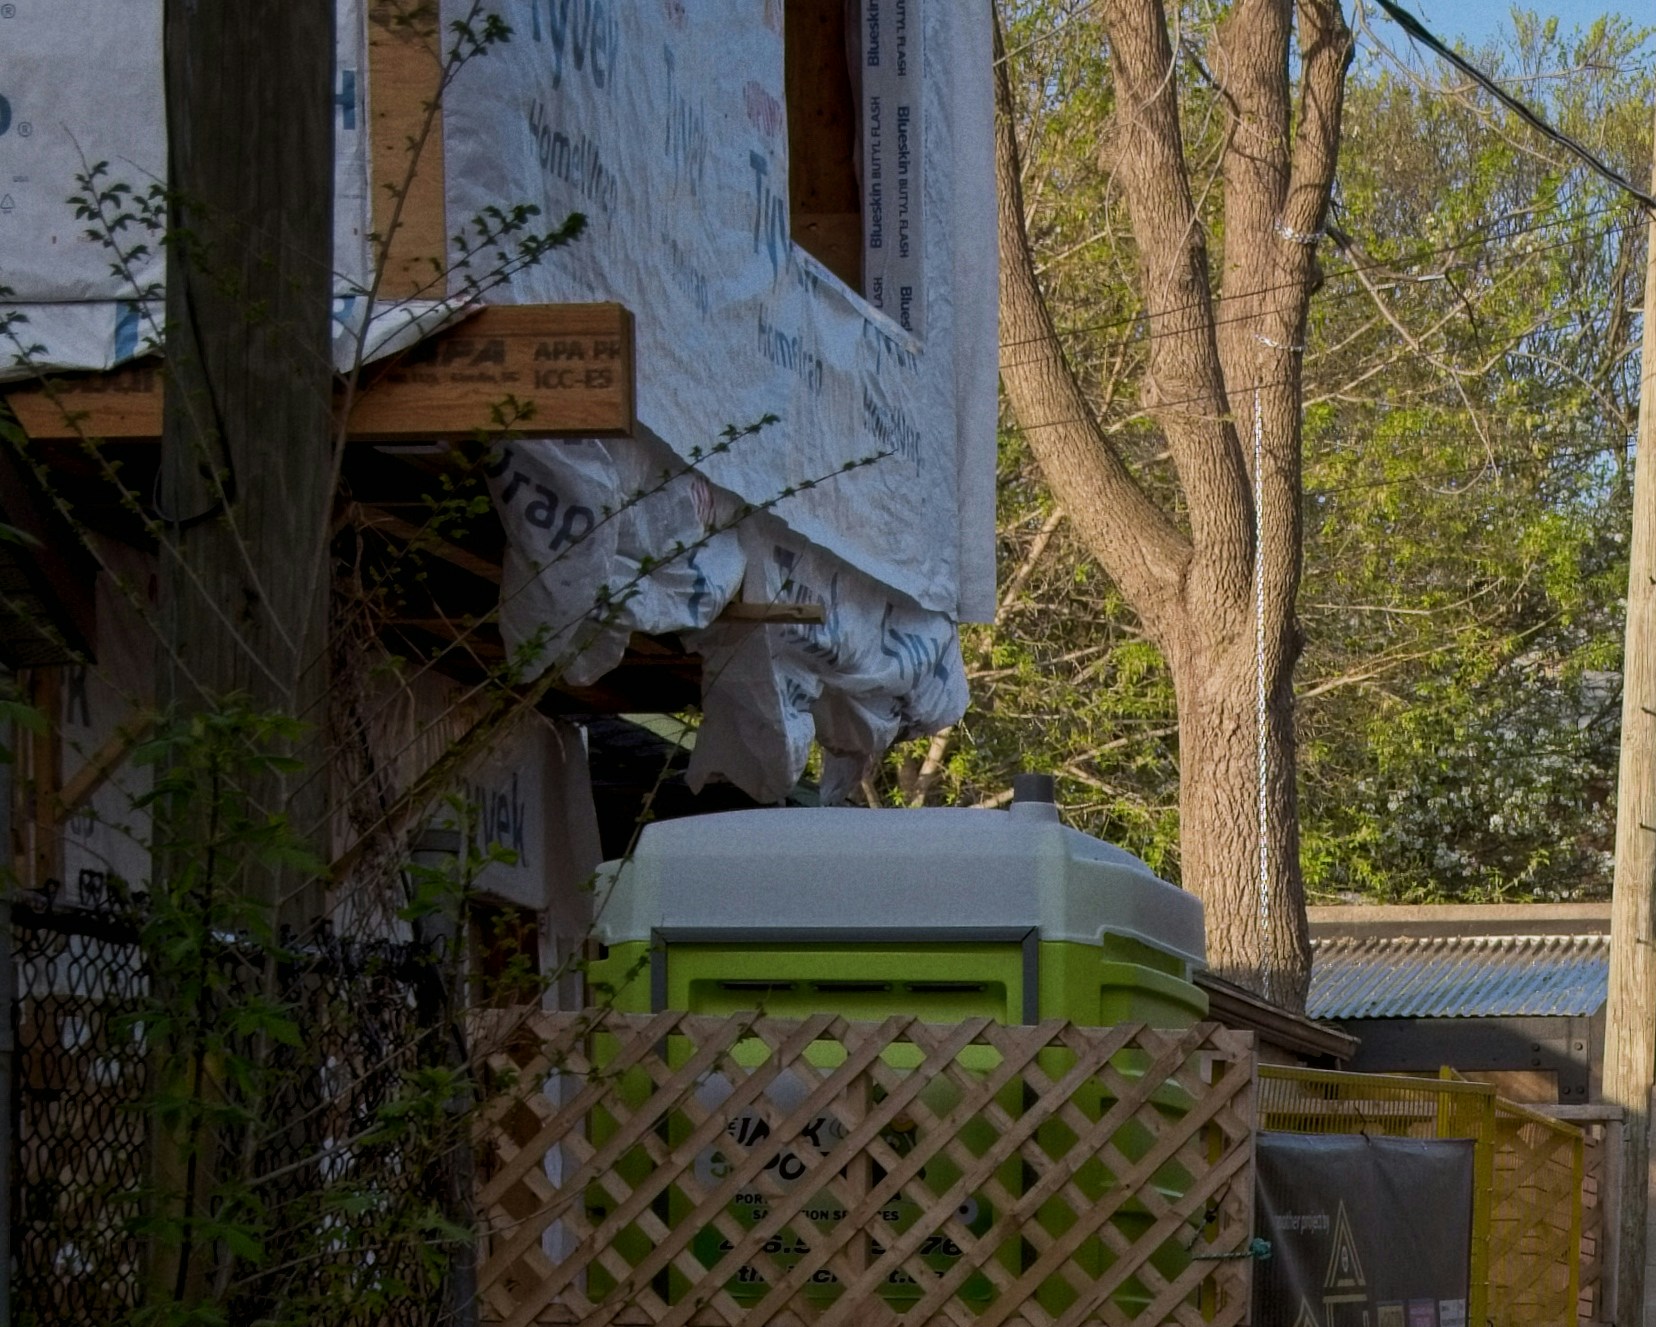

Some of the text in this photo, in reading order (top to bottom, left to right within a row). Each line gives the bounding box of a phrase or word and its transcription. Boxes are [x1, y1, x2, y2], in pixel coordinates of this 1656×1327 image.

[897, 0, 906, 76] UTYL FLASH
[870, 96, 882, 248] Blueskin BUTYL FLASH
[898, 106, 910, 258] Blueskin BUTYL FLASH
[873, 277, 883, 309] LASH
[534, 341, 584, 362] APA
[534, 369, 612, 390] ICC-ES
